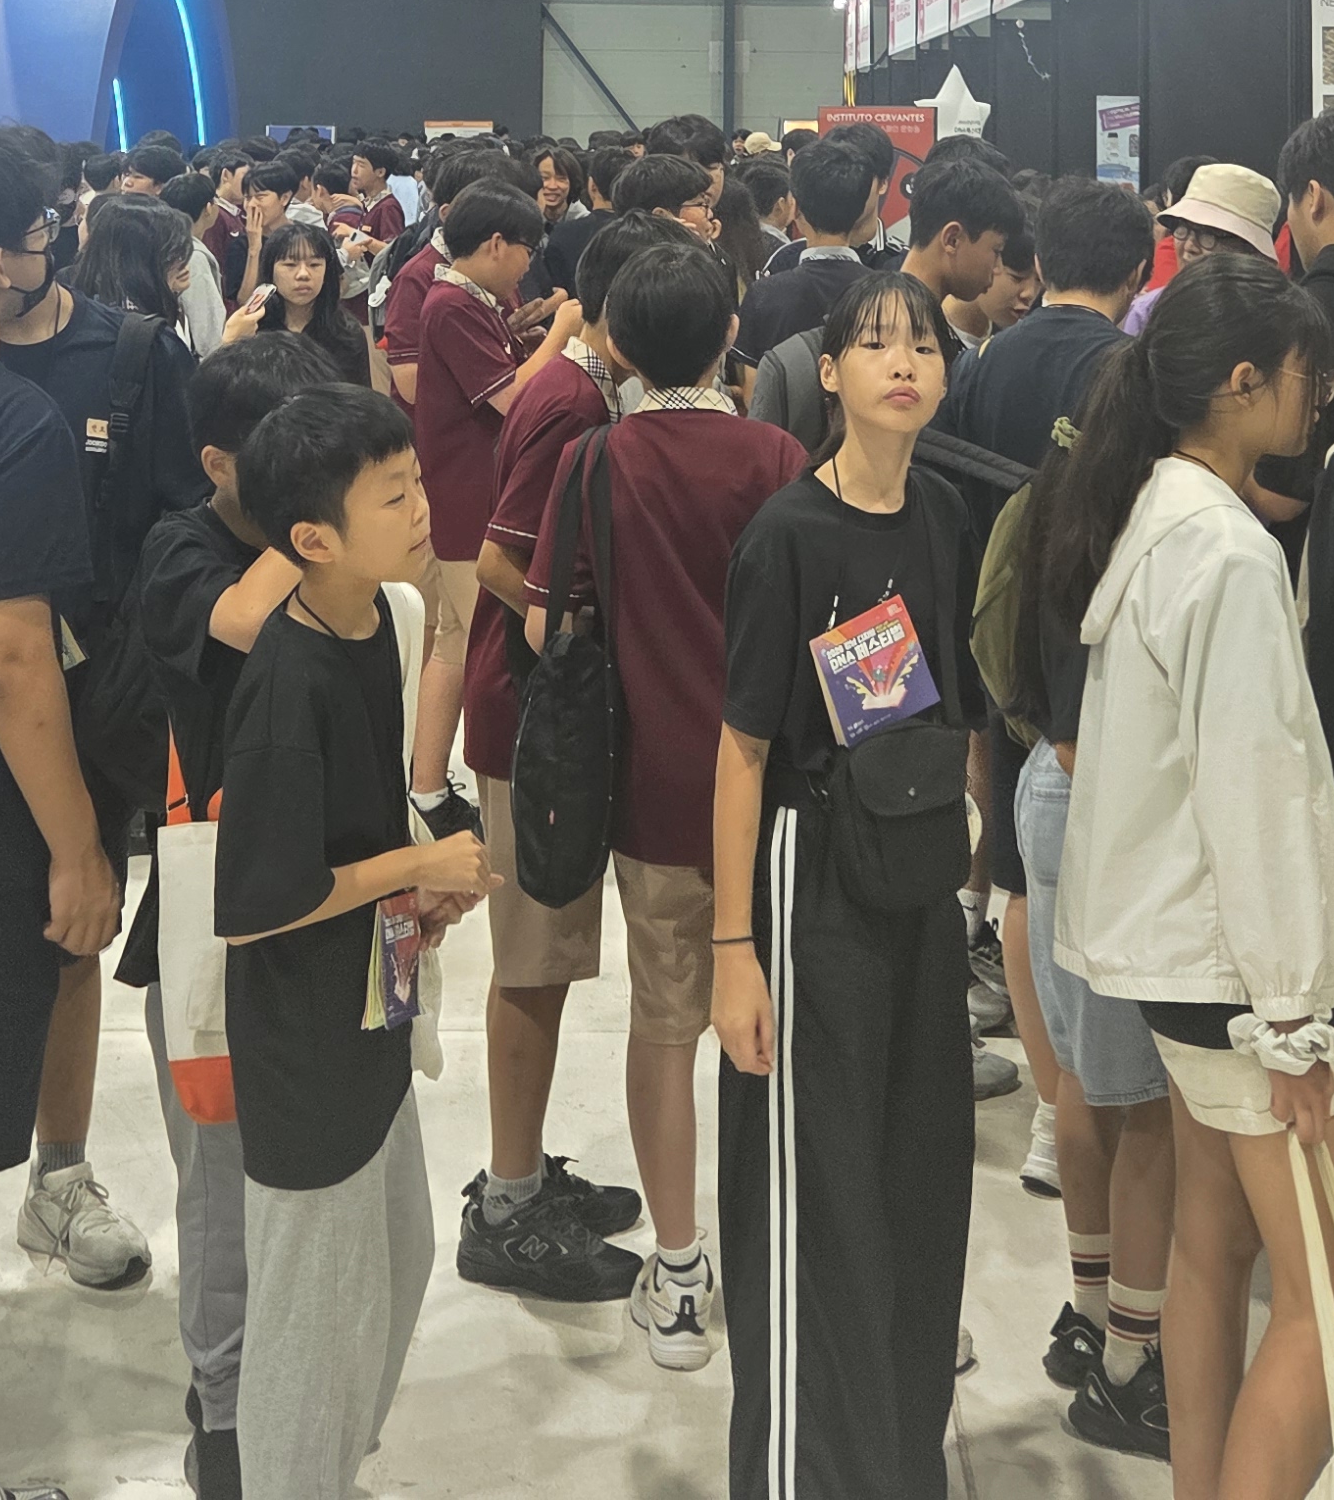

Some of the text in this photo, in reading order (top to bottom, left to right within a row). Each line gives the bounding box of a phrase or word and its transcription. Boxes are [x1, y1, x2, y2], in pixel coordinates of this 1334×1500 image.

[827, 113, 925, 122] INSTITUTO CERVANTES
[829, 623, 905, 672] DNA 페스티벌
